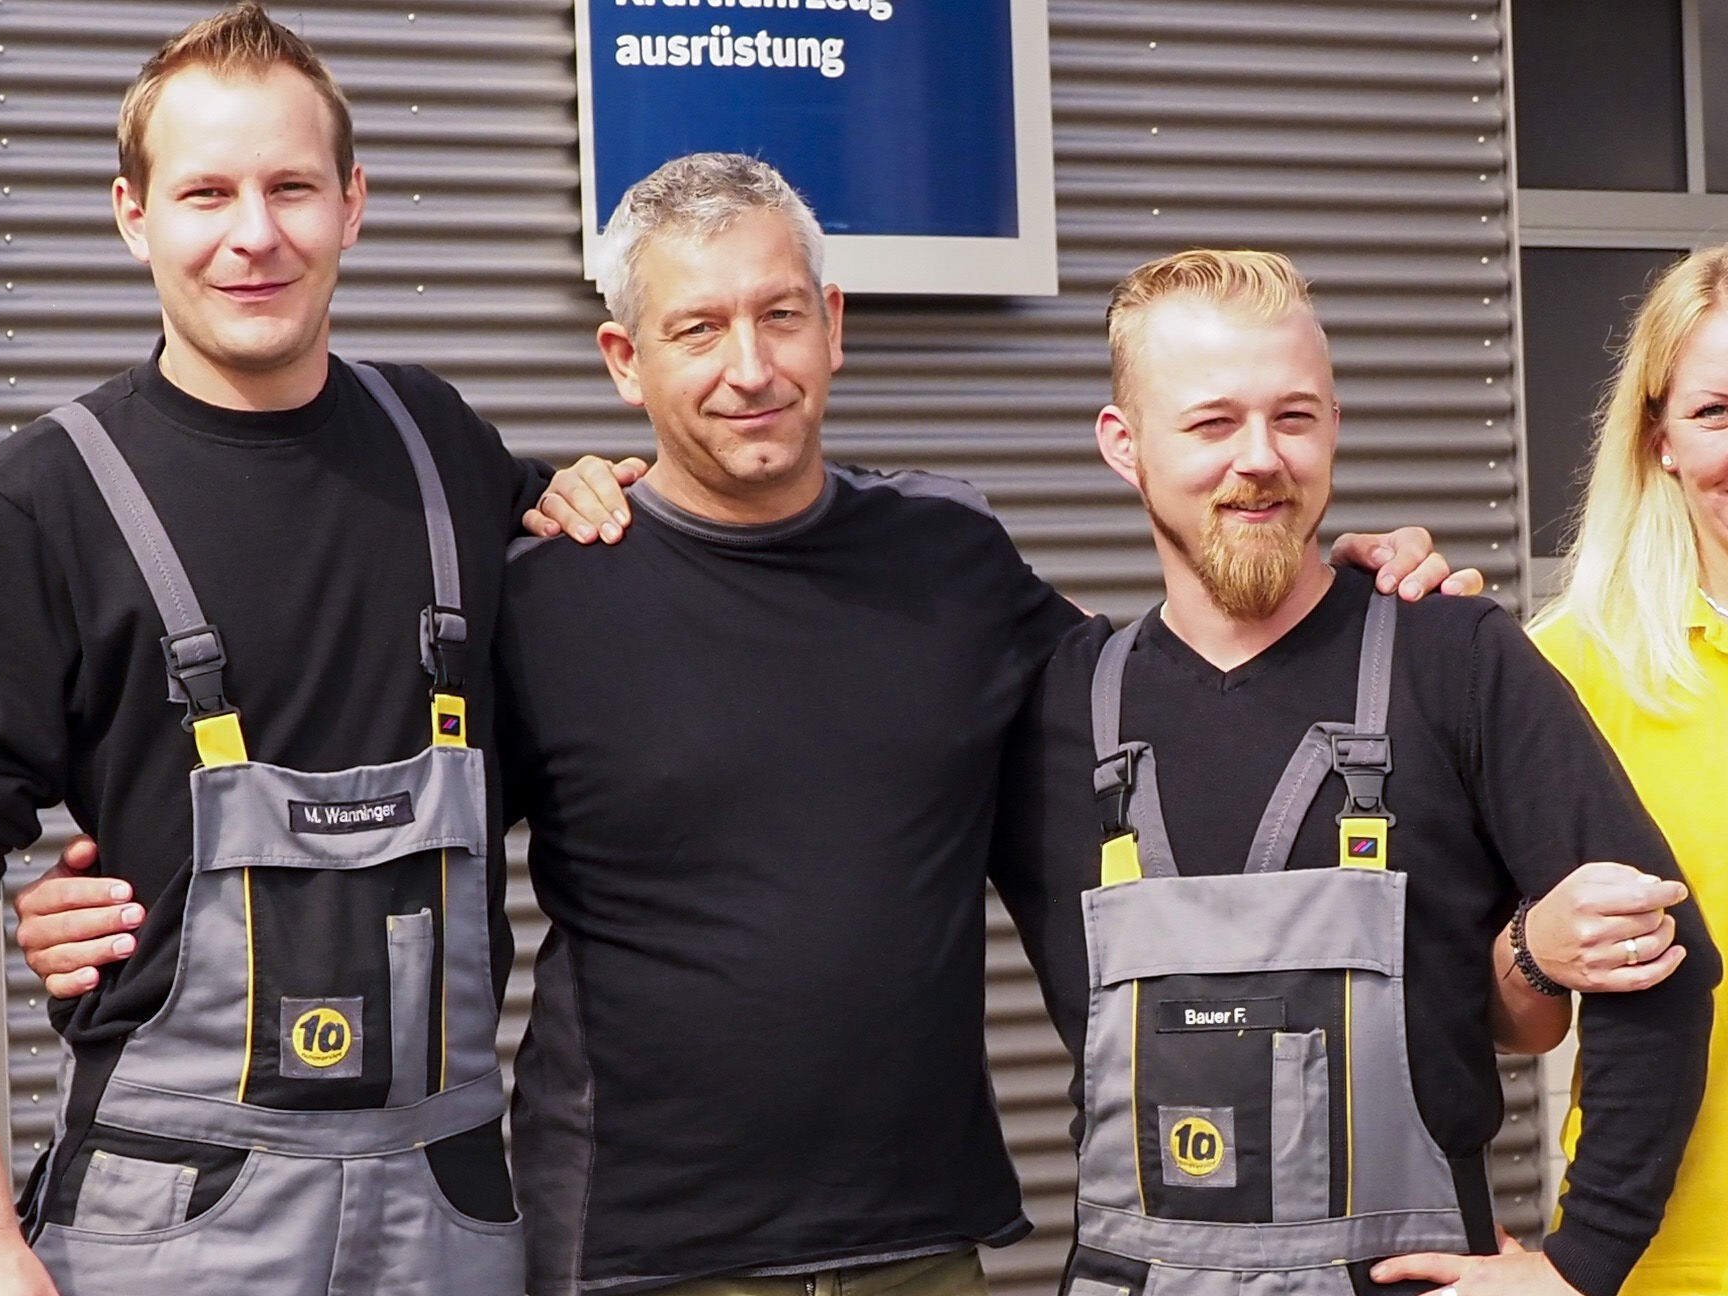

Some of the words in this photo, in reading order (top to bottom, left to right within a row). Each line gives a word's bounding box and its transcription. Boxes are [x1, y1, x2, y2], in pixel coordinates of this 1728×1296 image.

[615, 26, 845, 78] ausrüstung
[299, 1014, 346, 1053] 1a
[1184, 1008, 1232, 1025] Bauer
[1174, 1123, 1217, 1161] 1a
